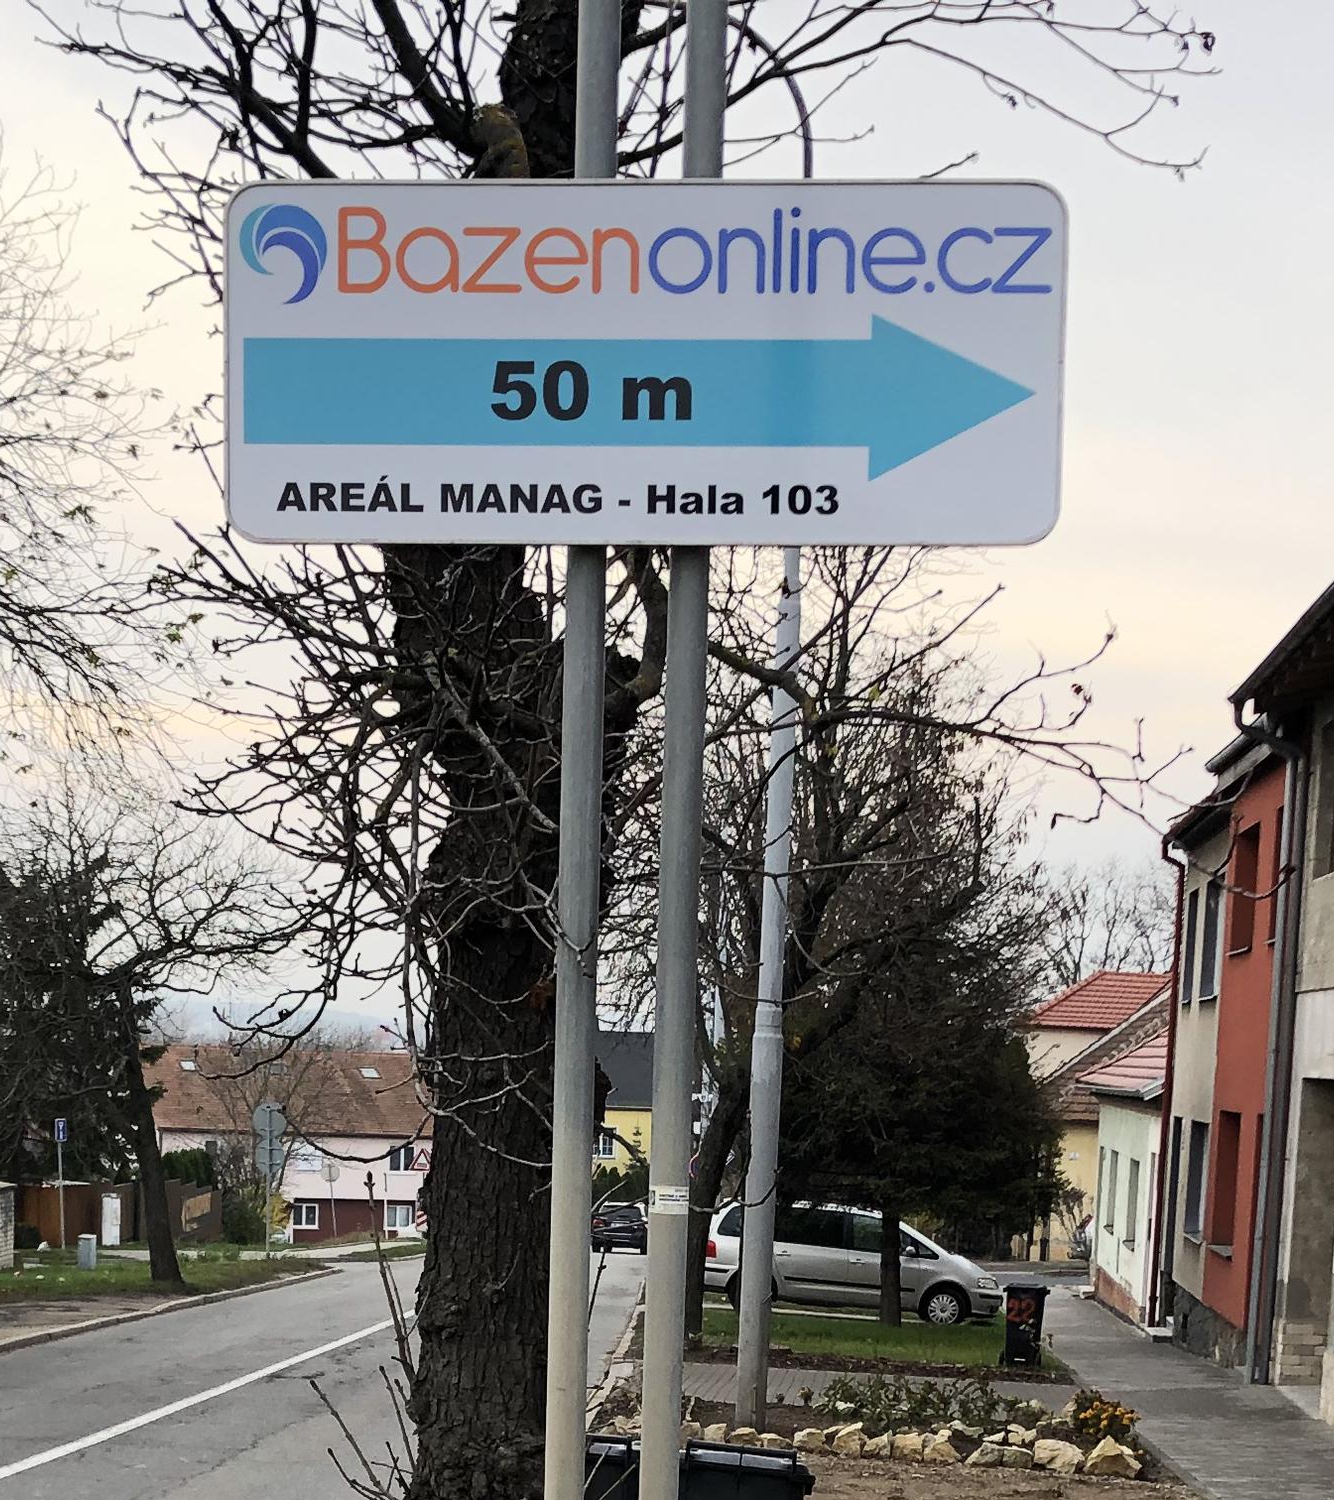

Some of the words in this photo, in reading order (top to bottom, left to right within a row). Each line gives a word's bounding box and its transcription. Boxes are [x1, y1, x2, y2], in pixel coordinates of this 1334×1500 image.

[337, 205, 1053, 296] Bazenonline.cz
[490, 360, 590, 422] 50
[621, 376, 693, 421] m
[276, 474, 424, 513] AREÁL
[440, 483, 603, 514] MANAG
[646, 484, 745, 515] Hala
[762, 484, 840, 515] 103
